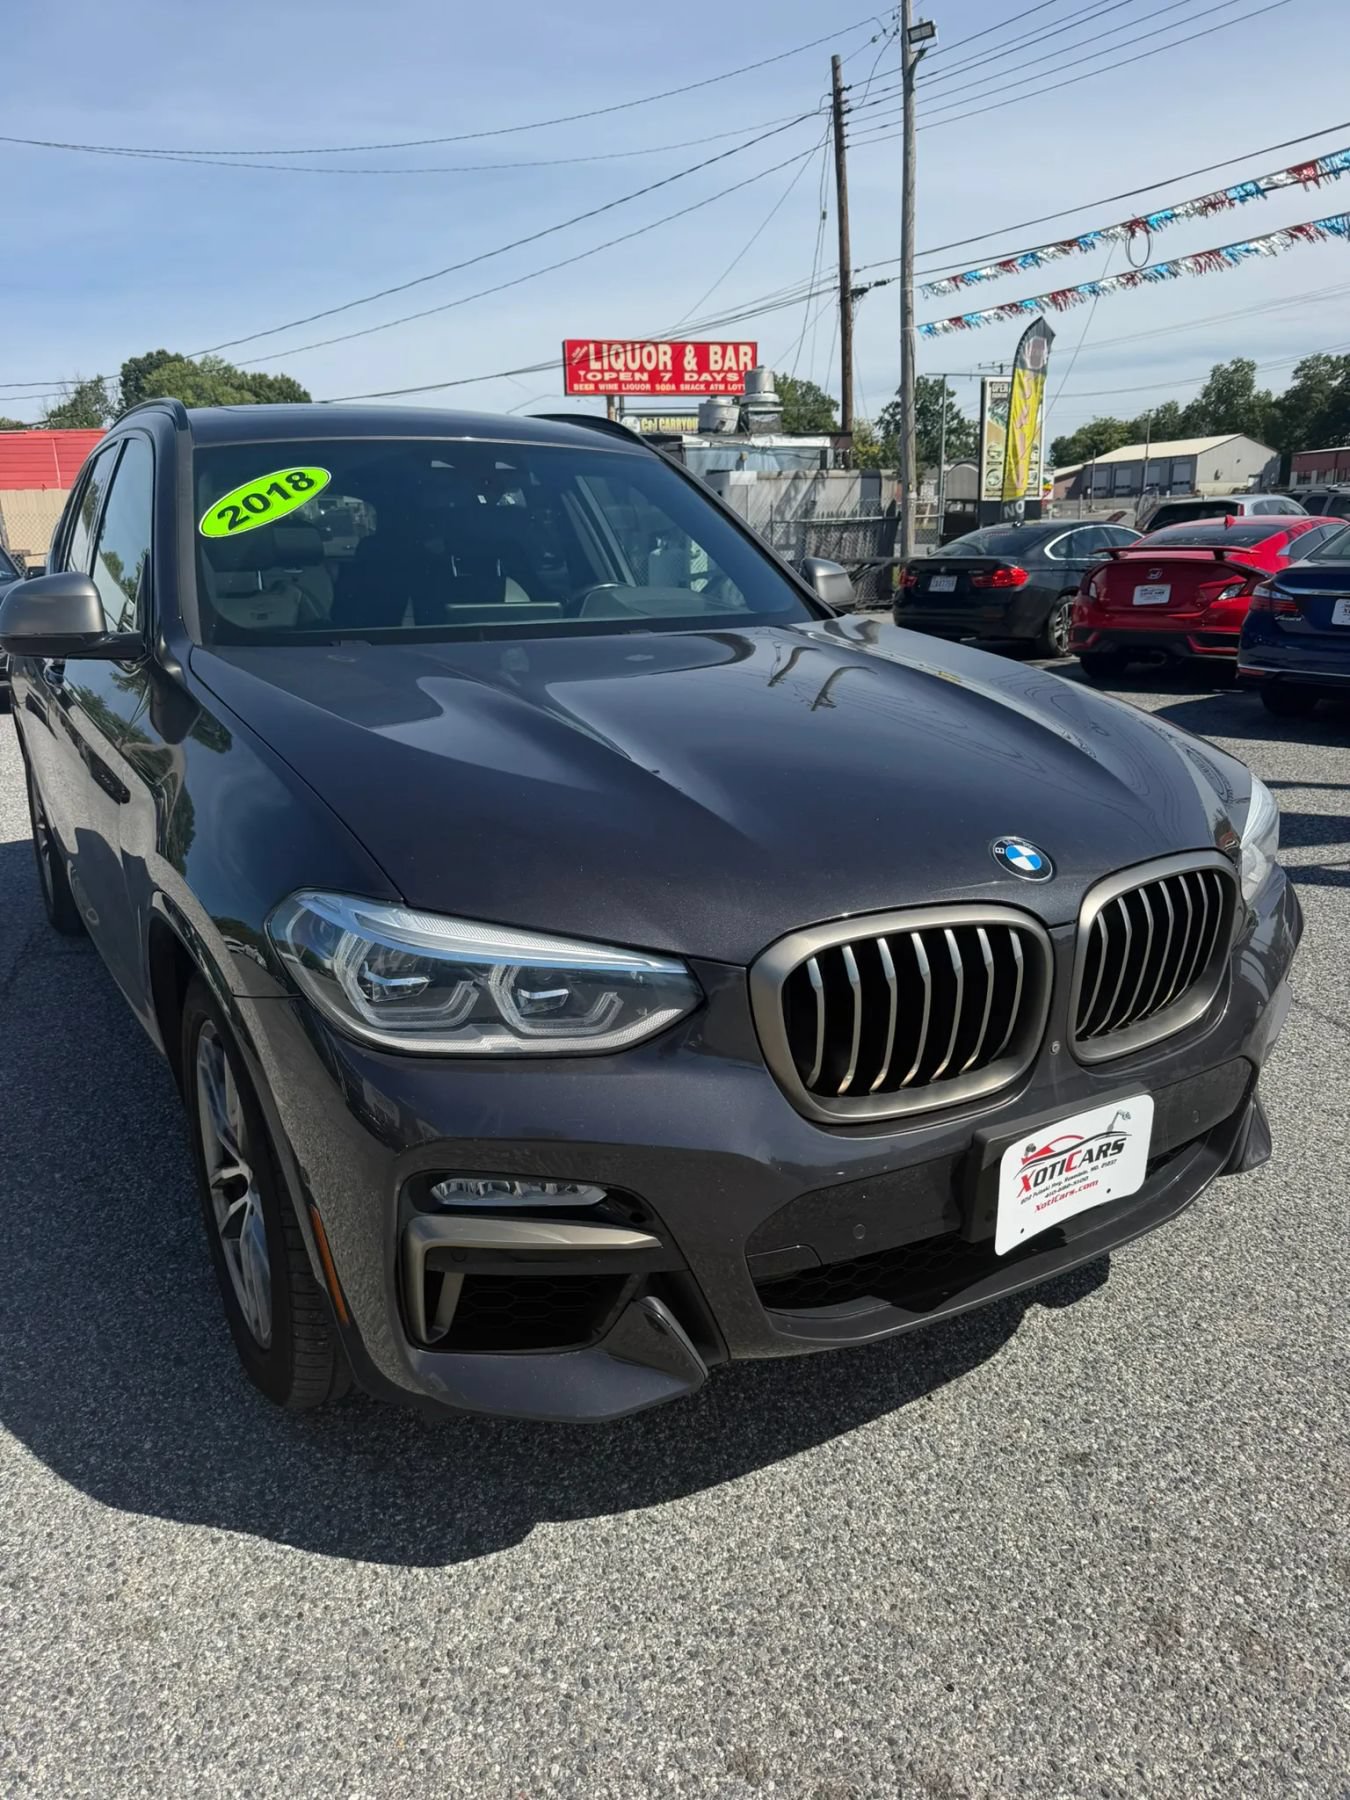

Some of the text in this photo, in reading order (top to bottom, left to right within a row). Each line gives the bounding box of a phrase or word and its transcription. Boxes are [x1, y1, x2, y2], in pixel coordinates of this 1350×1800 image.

[588, 343, 673, 371] LIQUOR
[683, 344, 698, 371] &
[709, 344, 753, 371] BAR
[586, 371, 740, 382] OPEN 7 DAYS
[573, 383, 595, 392] BEER
[598, 383, 619, 391] WINE
[621, 383, 652, 391] LIQUOR
[655, 383, 676, 391] SODA
[217, 471, 315, 531] 2018
